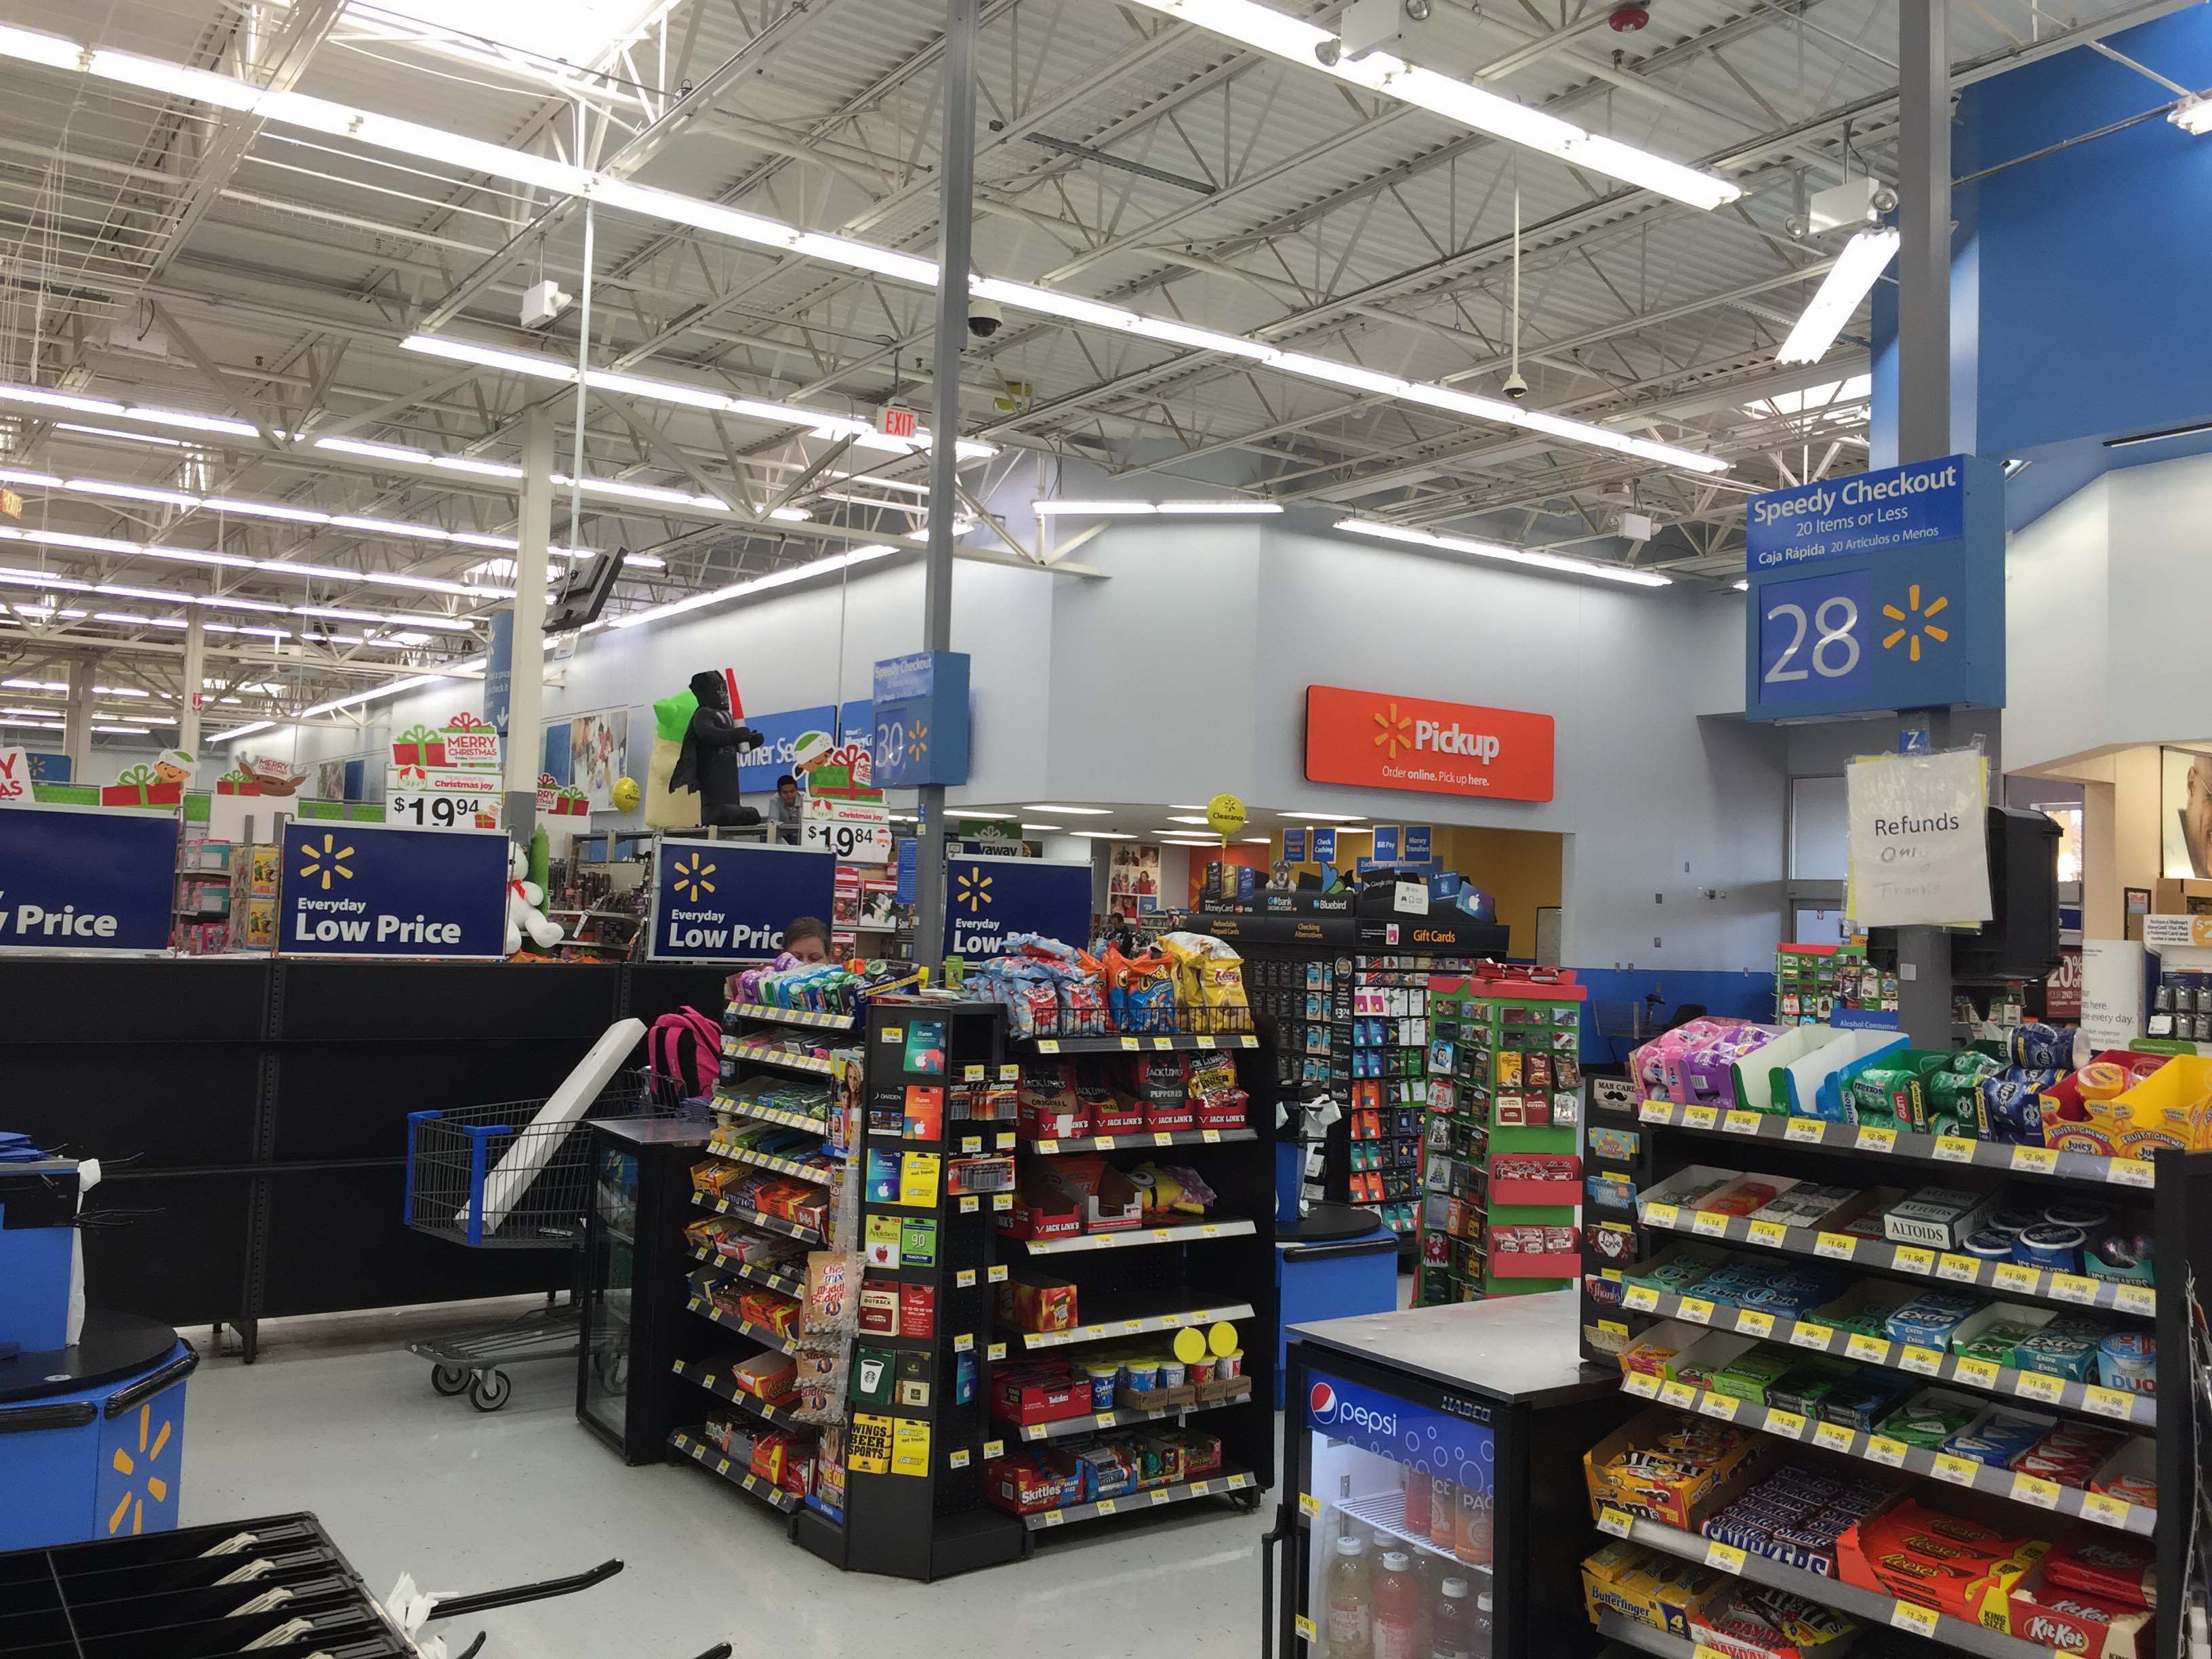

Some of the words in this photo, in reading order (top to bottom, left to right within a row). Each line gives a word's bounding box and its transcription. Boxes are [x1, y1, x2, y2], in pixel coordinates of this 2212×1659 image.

[885, 411, 914, 437] EXIT
[1754, 488, 1836, 525] Speedy
[1842, 466, 1957, 505] Checkout
[1795, 521, 1812, 537] 20
[1816, 514, 1854, 533] Items
[1858, 512, 1874, 526] or
[1877, 506, 1908, 523] Less
[1758, 551, 1782, 565] Caja
[1785, 543, 1825, 564] Rápida
[1830, 541, 1843, 553] 20
[1845, 533, 1889, 550] Artículos
[1892, 533, 1900, 542] o
[1902, 526, 1939, 541] Menos
[1764, 596, 1860, 683] 28
[900, 657, 933, 673] Checkout
[447, 735, 497, 749] MERRY
[876, 721, 903, 768] 30
[1415, 720, 1500, 765] Pickup
[1908, 731, 1921, 749] Z
[449, 747, 498, 757] CHRISTMAS
[258, 764, 288, 775] CHRISTMAS
[259, 758, 289, 771] MERRY
[1382, 765, 1407, 779] Order
[1408, 769, 1437, 782] online.
[1438, 771, 1455, 783] Pick
[1456, 775, 1467, 785] up
[1468, 775, 1490, 786] here.
[434, 780, 479, 789] Christmas
[480, 782, 494, 791] joy
[838, 811, 872, 821] Christmas
[872, 813, 884, 823] joy
[1212, 811, 1244, 823] Clearance
[1875, 812, 1959, 836] Refunds
[1316, 838, 1332, 846] Check
[1386, 842, 1395, 850] Pay
[1409, 837, 1427, 845] Money
[1314, 846, 1334, 854] Cashing
[1406, 844, 1429, 853] Transfers
[298, 897, 365, 916] Everyday
[1205, 903, 1234, 914] MoneyCard
[1319, 900, 1347, 909] Bluebird
[16, 905, 118, 937] Price
[671, 909, 725, 924] Everyday
[295, 913, 371, 943] Low
[376, 914, 462, 944] Price
[956, 918, 1000, 933] Everyday
[1213, 920, 1237, 928] Reloadable
[1297, 922, 1321, 933] Checking
[668, 922, 726, 948] Low
[1210, 928, 1227, 936] Prepaid
[1227, 928, 1240, 937] Cards
[1294, 930, 1324, 939] Alternatives
[1413, 929, 1430, 943] Gift
[1431, 930, 1456, 943] Cards
[953, 930, 1002, 954] Low
[2062, 990, 2073, 999] 2ND
[2090, 1001, 2109, 1010] here.
[1839, 1019, 1864, 1029] Alcohol
[1864, 1021, 1898, 1030] Consumer
[2091, 1013, 2114, 1025] every
[2115, 1013, 2135, 1025] day.
[989, 1084, 1016, 1092] Energizer
[1598, 1082, 1615, 1090] MAN
[1853, 1082, 1885, 1096] mentos
[880, 1092, 902, 1101] DARDEN
[1149, 1089, 1184, 1099] PEPPERED
[1031, 1098, 1068, 1107] ORIGINAL
[1896, 1095, 1907, 1118] GUM
[1107, 1118, 1124, 1126] JACK
[1123, 1117, 1143, 1126] LINK'S
[1158, 1115, 1174, 1124] JACK
[1174, 1115, 1193, 1124] LINK'S
[1209, 1115, 1225, 1124] JACK
[1226, 1114, 1246, 1124] LINK'S
[2049, 1125, 2080, 1138] FRUITY
[2080, 1127, 2110, 1143] CHEWS
[2121, 1132, 2152, 1145] FRUITY
[2154, 1132, 2186, 1149] CHEWS
[1945, 1143, 1966, 1152] $2.96
[2065, 1141, 2093, 1151] Juicy
[1045, 1223, 1061, 1233] JACK
[1891, 1221, 1944, 1242] ALTOIDS
[912, 1234, 926, 1247] 90
[1904, 1253, 1924, 1264] $1.98
[863, 1297, 892, 1305] OUTBACK
[1897, 1310, 1956, 1322] Extra
[1904, 1326, 1923, 1335] Extra
[1906, 1335, 1925, 1345] Extra
[2024, 1336, 2090, 1350] Extra
[2036, 1354, 2056, 1364] Extra
[1723, 1367, 1771, 1381] DOUBLEMINT
[2038, 1363, 2058, 1373] Extra
[2112, 1374, 2156, 1391] DUO
[1340, 1401, 1397, 1437] pepsi
[852, 1422, 887, 1437] WINGS
[850, 1434, 886, 1449] BEER
[848, 1444, 884, 1460] SPORTS
[1021, 1485, 1062, 1504] Skittles
[1591, 1586, 1650, 1617] Butterfinger
[1669, 1615, 1684, 1629] 4
[1984, 1610, 2007, 1623] KING
[1984, 1618, 2006, 1633] SIZE
